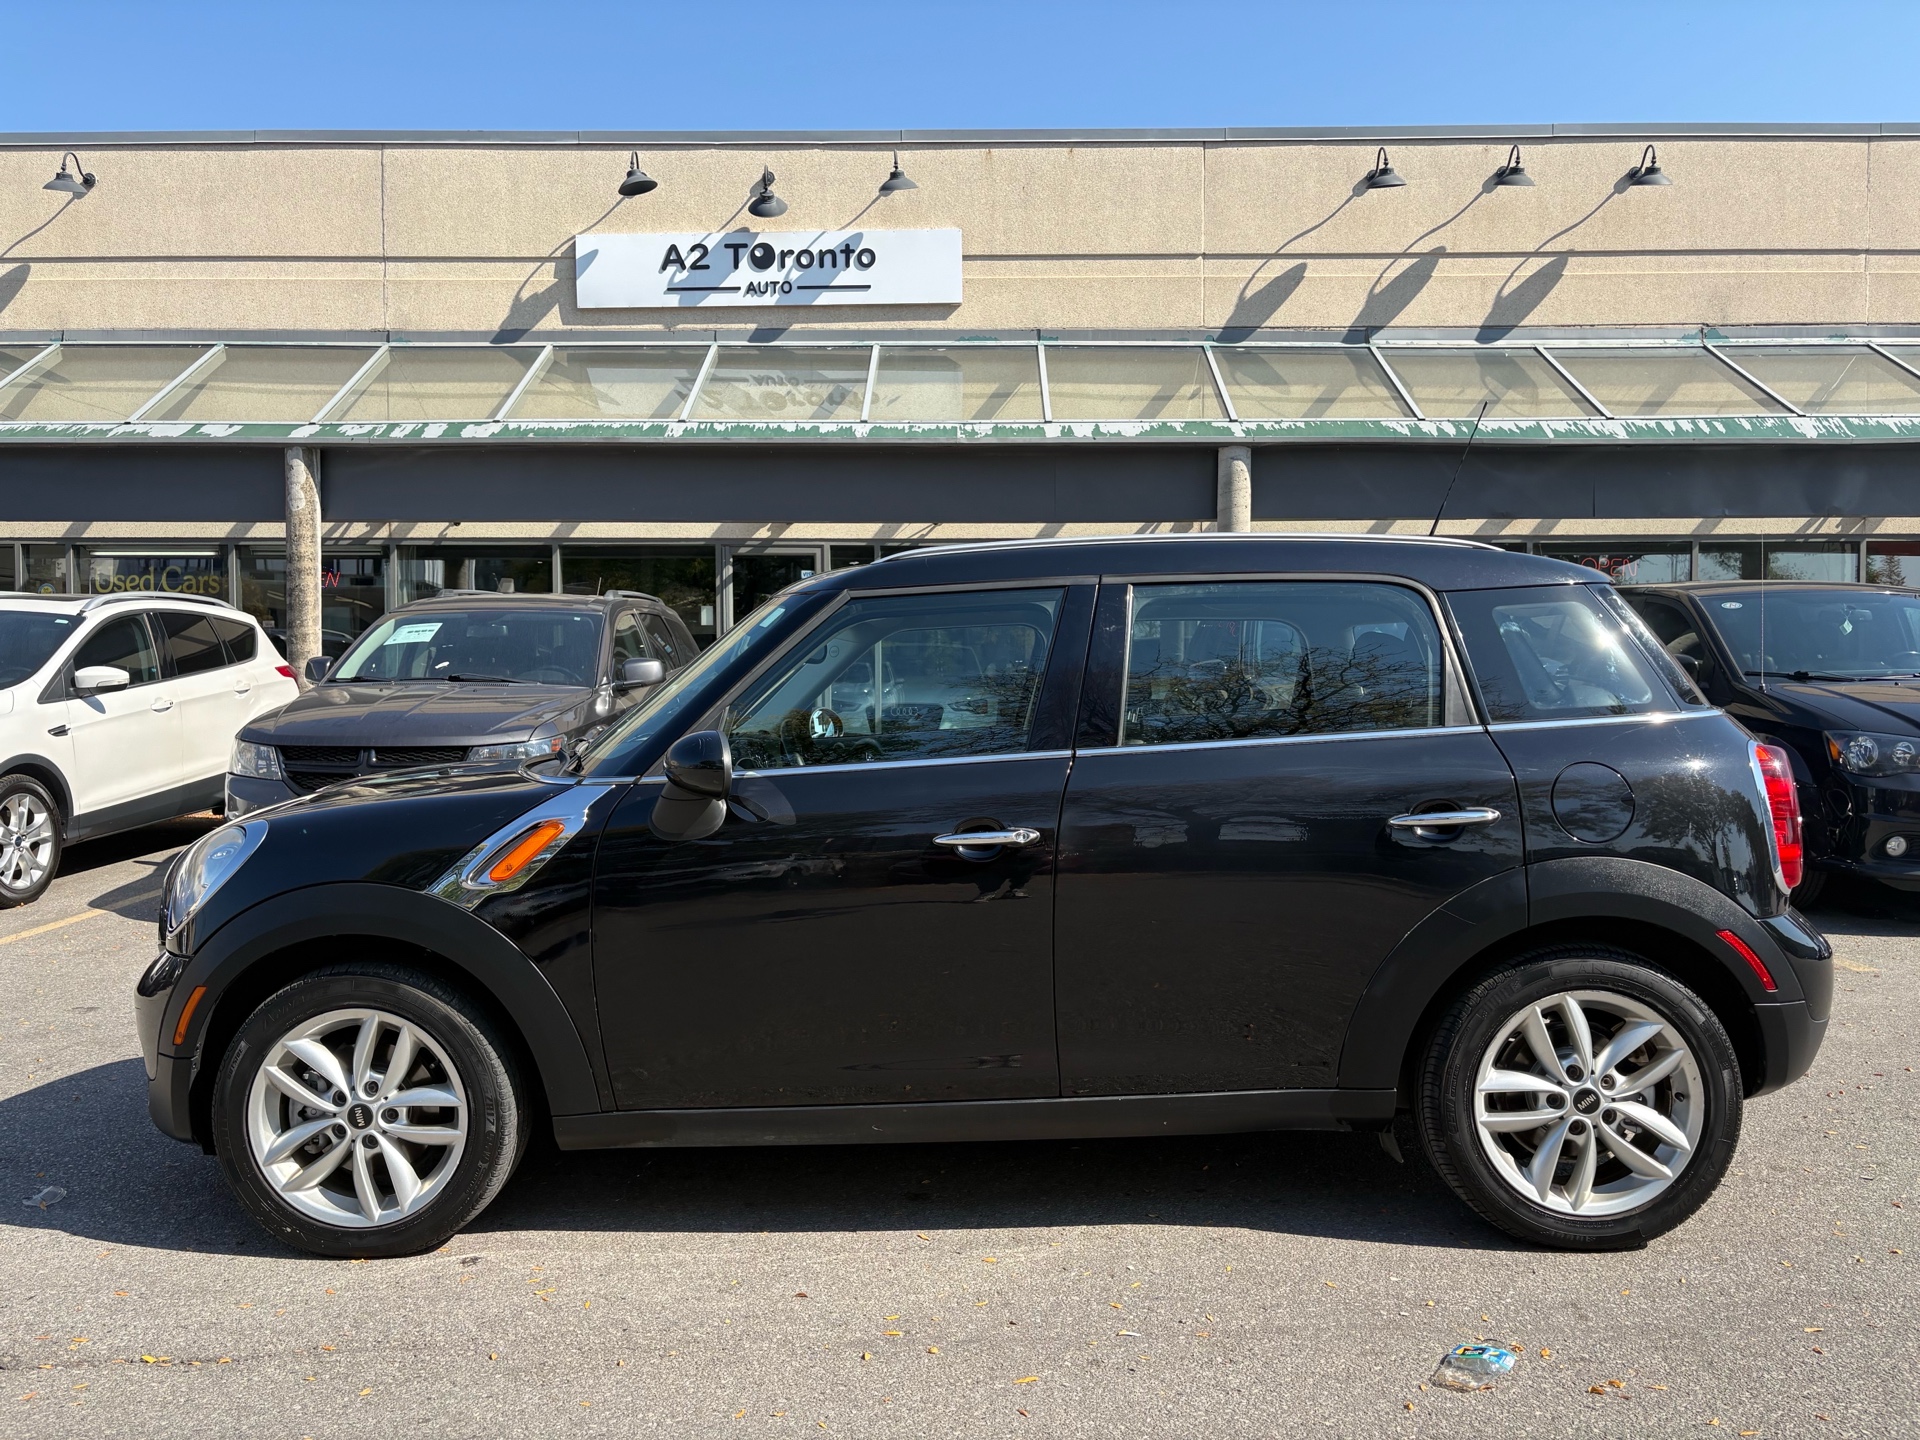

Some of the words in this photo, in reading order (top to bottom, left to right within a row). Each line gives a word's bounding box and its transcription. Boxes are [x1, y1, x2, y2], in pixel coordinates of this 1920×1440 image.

[661, 243, 711, 271] A2
[746, 280, 793, 295] AUTO
[94, 564, 155, 594] Used
[161, 565, 221, 594] Cars
[1577, 1093, 1597, 1111] MINI
[354, 1106, 366, 1127] MINI
